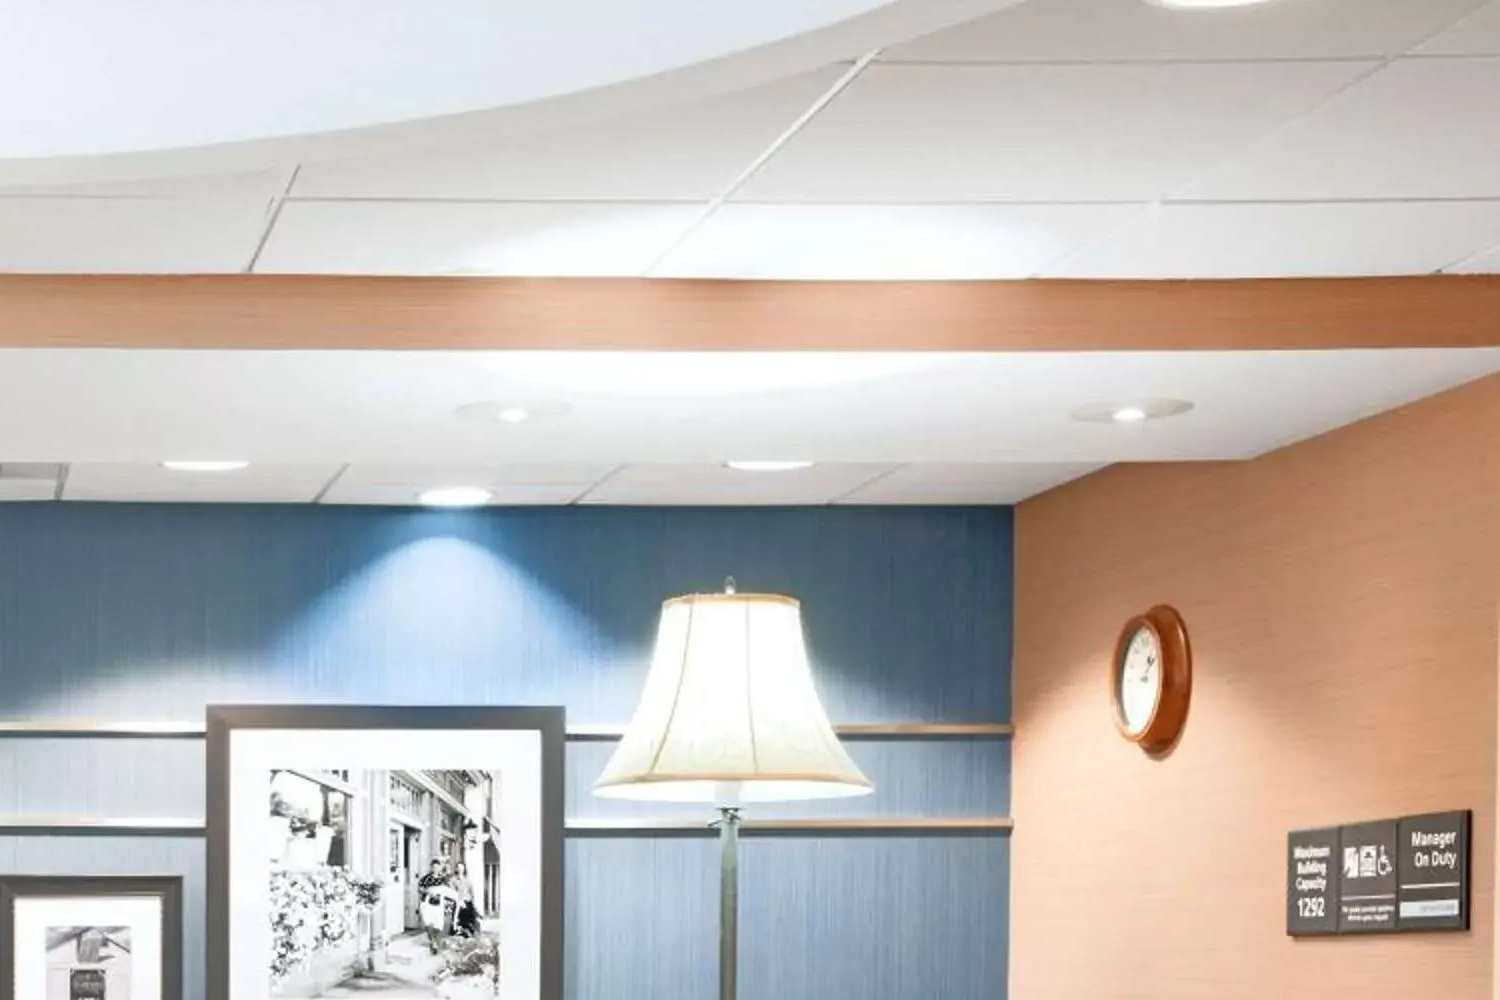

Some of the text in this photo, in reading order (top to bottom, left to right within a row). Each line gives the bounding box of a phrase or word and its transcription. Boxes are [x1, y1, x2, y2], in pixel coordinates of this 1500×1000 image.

[1411, 831, 1456, 848] Manager
[1414, 850, 1457, 869] On Duty
[1297, 897, 1325, 917] 1292
